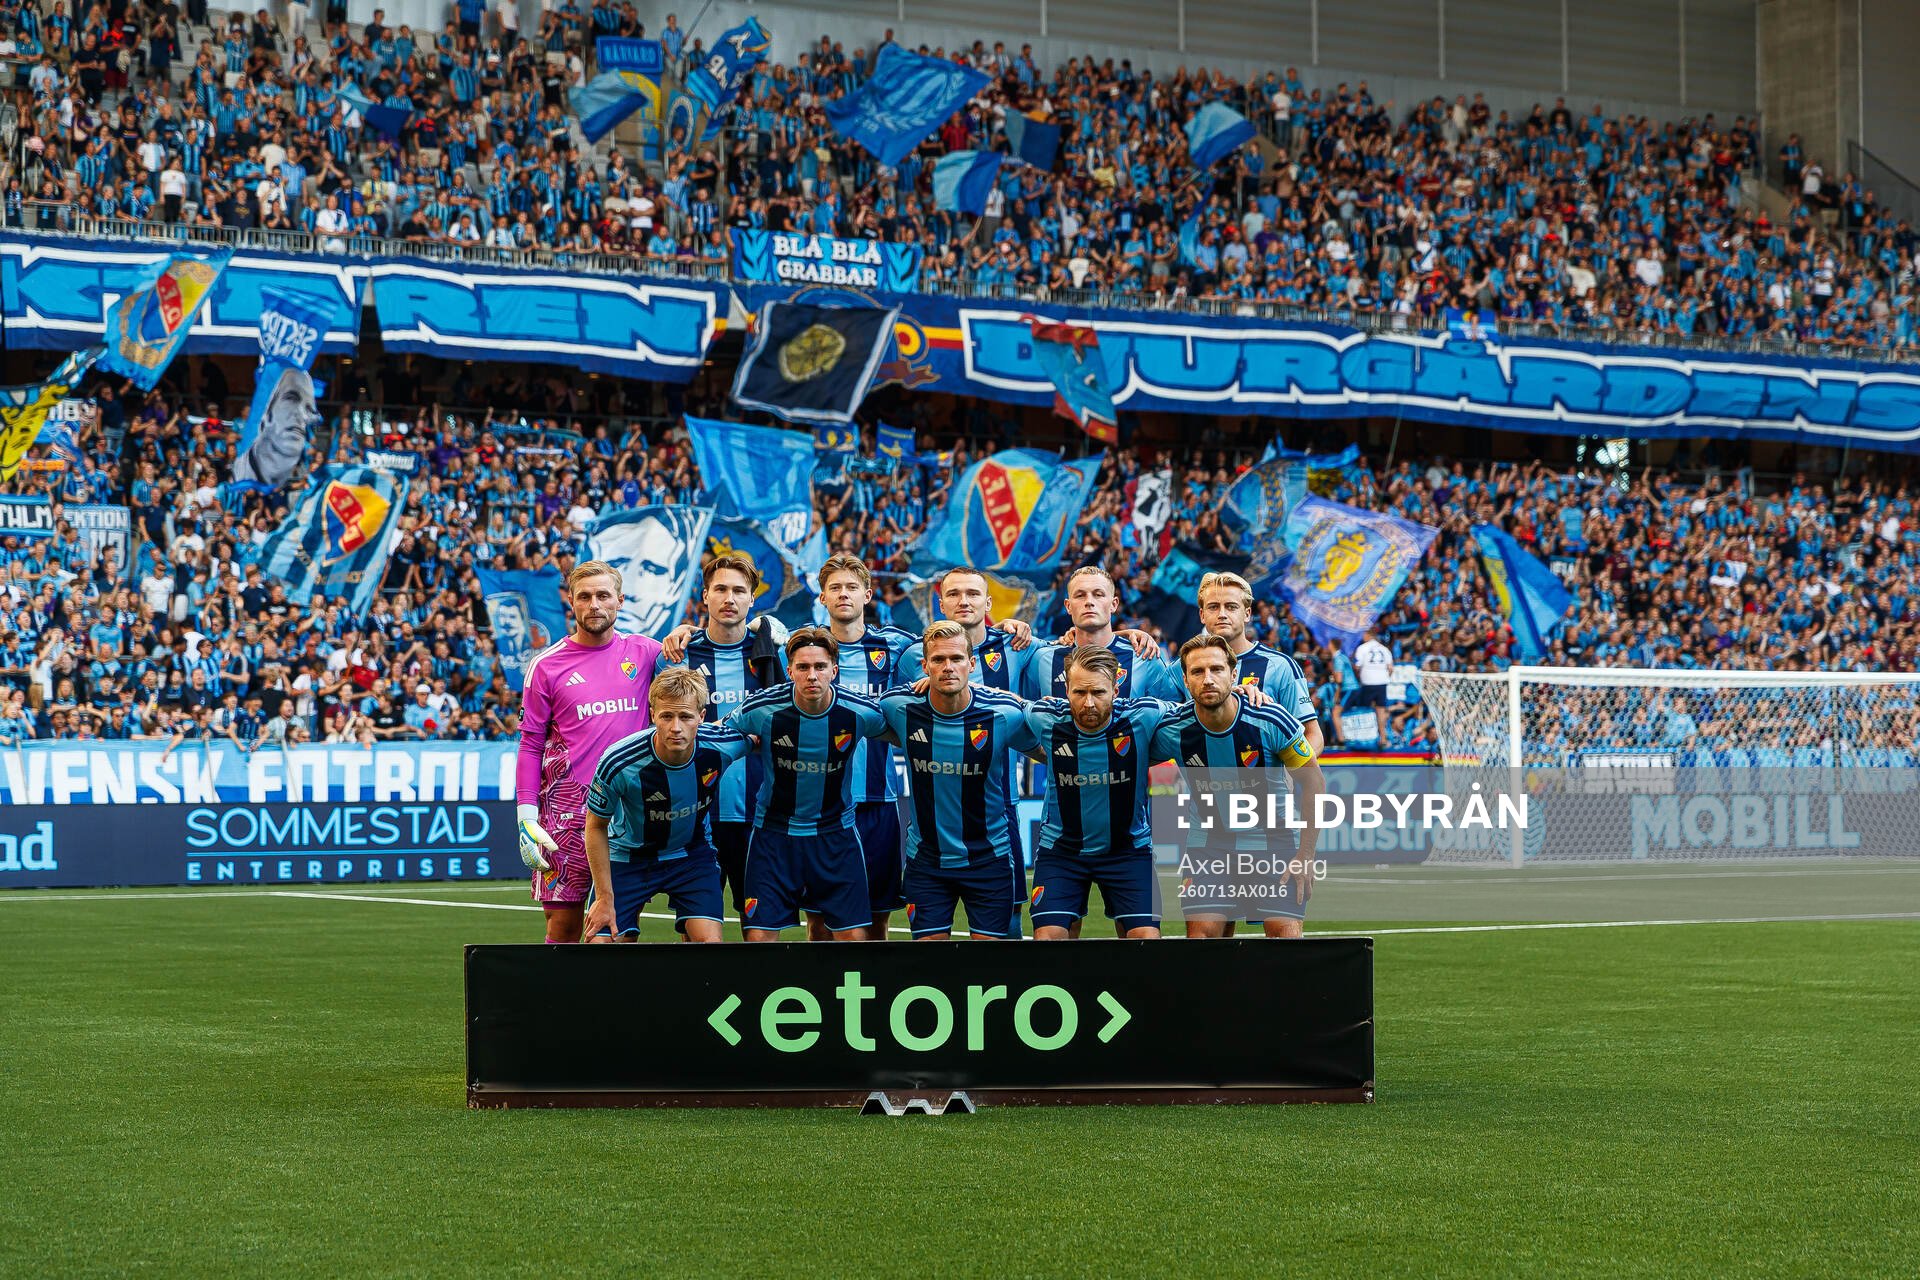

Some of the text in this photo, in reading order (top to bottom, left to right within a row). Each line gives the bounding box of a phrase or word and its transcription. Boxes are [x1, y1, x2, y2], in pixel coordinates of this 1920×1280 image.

[773, 234, 882, 265] BLÅ BLÅ
[777, 260, 878, 287] GRABBAR
[577, 697, 639, 721] MOBILL
[777, 757, 844, 774] MOBILL
[912, 758, 983, 776] MOBILL
[1058, 770, 1131, 787] MOBILL
[649, 797, 713, 822] MOBILL
[186, 805, 491, 847] SOMMESTAD
[1631, 794, 1861, 859] MOBILL
[187, 859, 491, 882] ENTERPRISES
